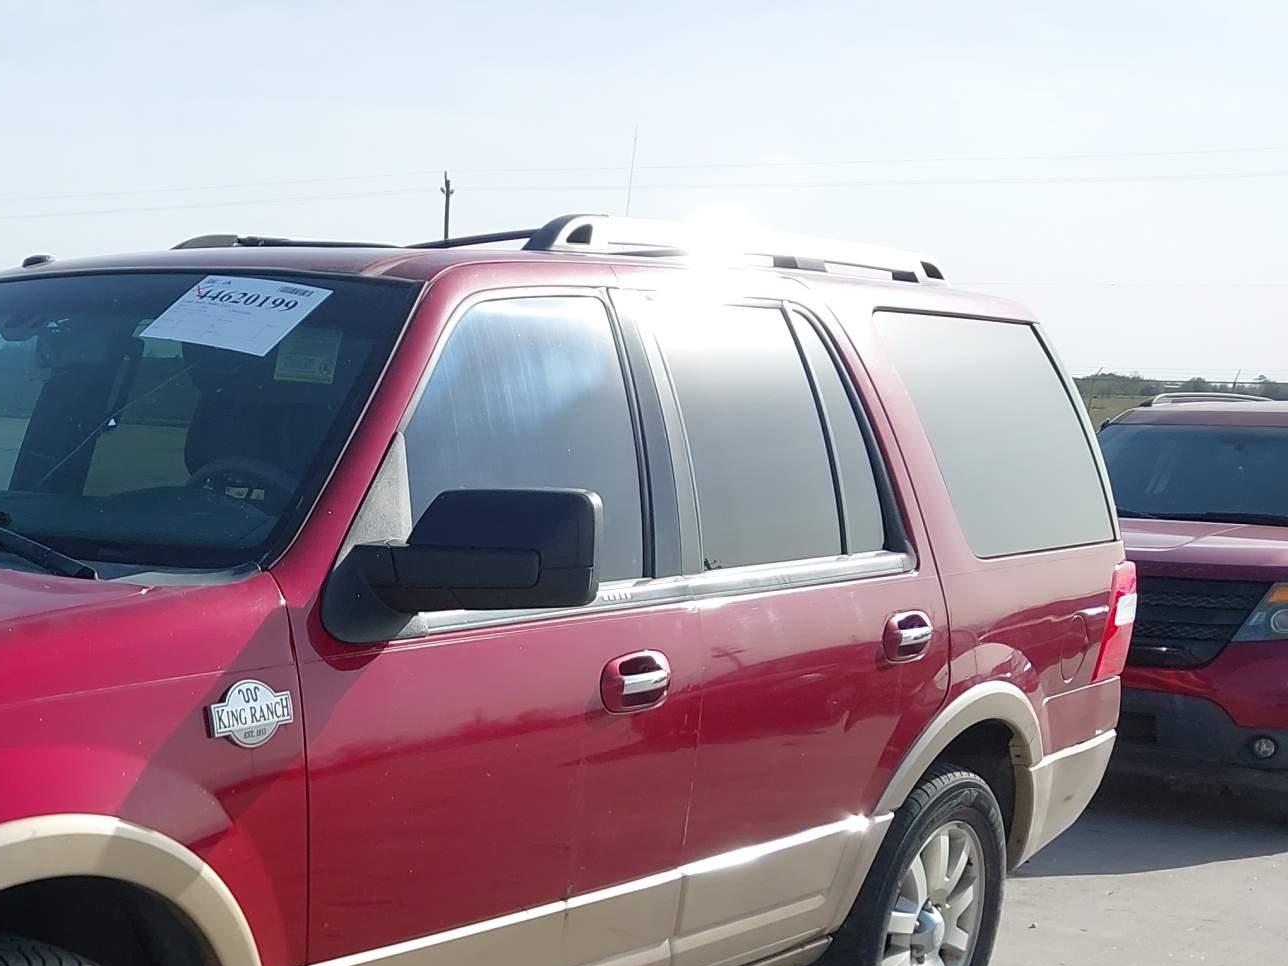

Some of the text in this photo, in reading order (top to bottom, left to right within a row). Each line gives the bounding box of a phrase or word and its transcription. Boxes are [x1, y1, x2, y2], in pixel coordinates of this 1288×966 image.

[197, 287, 300, 312] 44620199
[216, 696, 290, 730] KING RANCH
